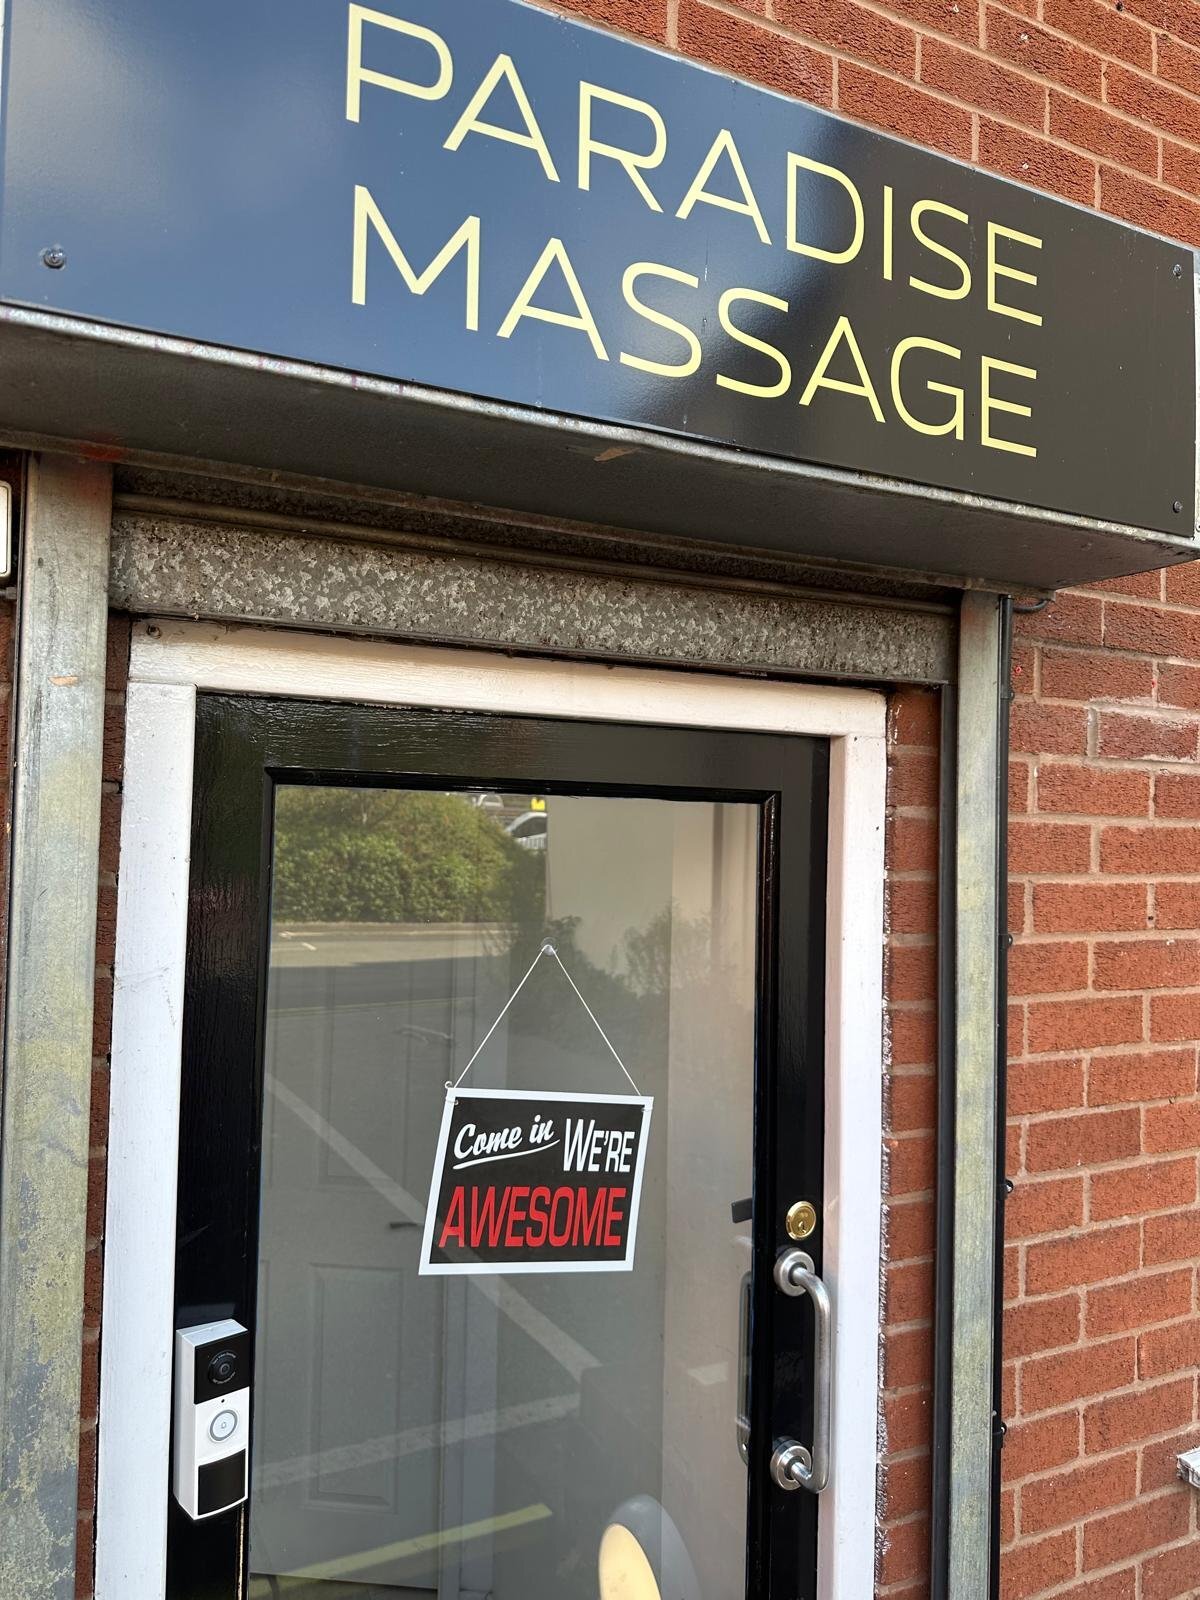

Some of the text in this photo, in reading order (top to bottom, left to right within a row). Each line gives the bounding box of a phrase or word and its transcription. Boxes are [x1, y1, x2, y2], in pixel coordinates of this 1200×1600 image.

[346, 3, 1044, 327] PARADISE
[352, 184, 1039, 458] MASSAGE
[439, 1186, 626, 1247] AWESOME
[454, 1115, 635, 1172] Come in WE'RE
